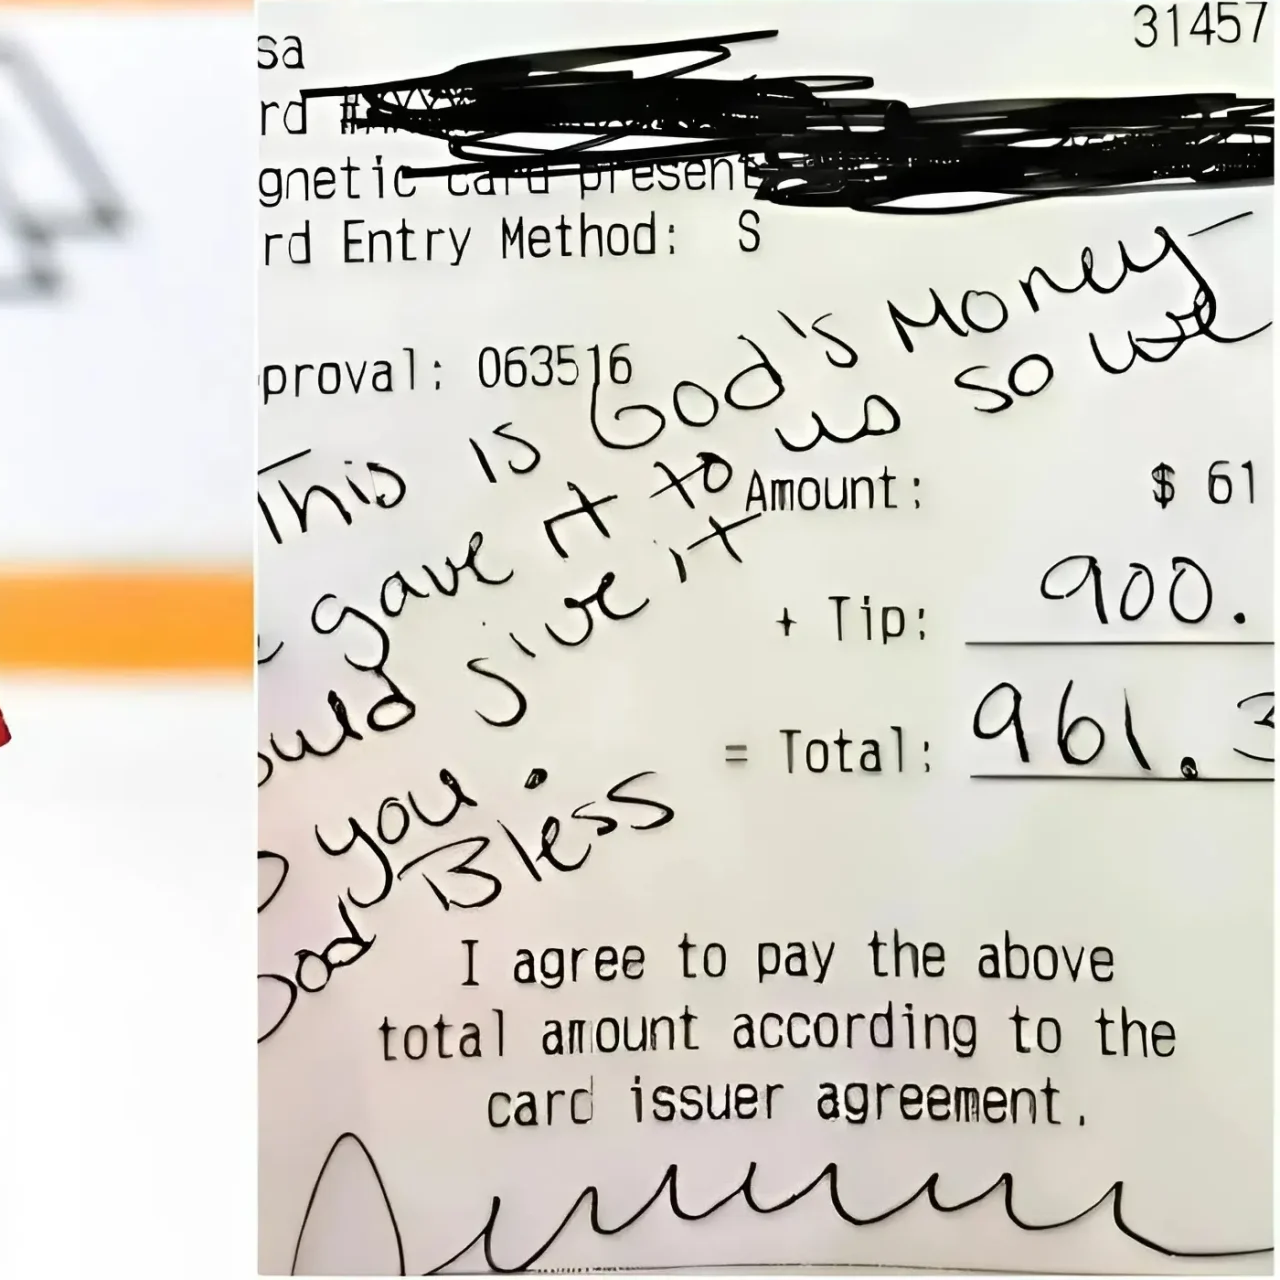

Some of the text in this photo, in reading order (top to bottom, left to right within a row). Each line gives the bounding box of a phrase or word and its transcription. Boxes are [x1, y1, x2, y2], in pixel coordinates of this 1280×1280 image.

[1134, 1, 1268, 48] 31457
[258, 35, 305, 69] sa
[258, 155, 416, 207] gnetic
[264, 209, 761, 266] rd Entry Method: S
[479, 343, 632, 388] 063516
[258, 448, 407, 544] This
[746, 460, 1255, 512] Amount: $ 61
[311, 531, 514, 672] gave
[1041, 555, 1246, 625] 900.
[829, 595, 926, 645] Tip:
[780, 726, 931, 774] Total:
[461, 928, 1115, 989] I agree to pay the above
[378, 1001, 1176, 1061] total amount according to the
[487, 1075, 1086, 1128] card issuer agreement.
